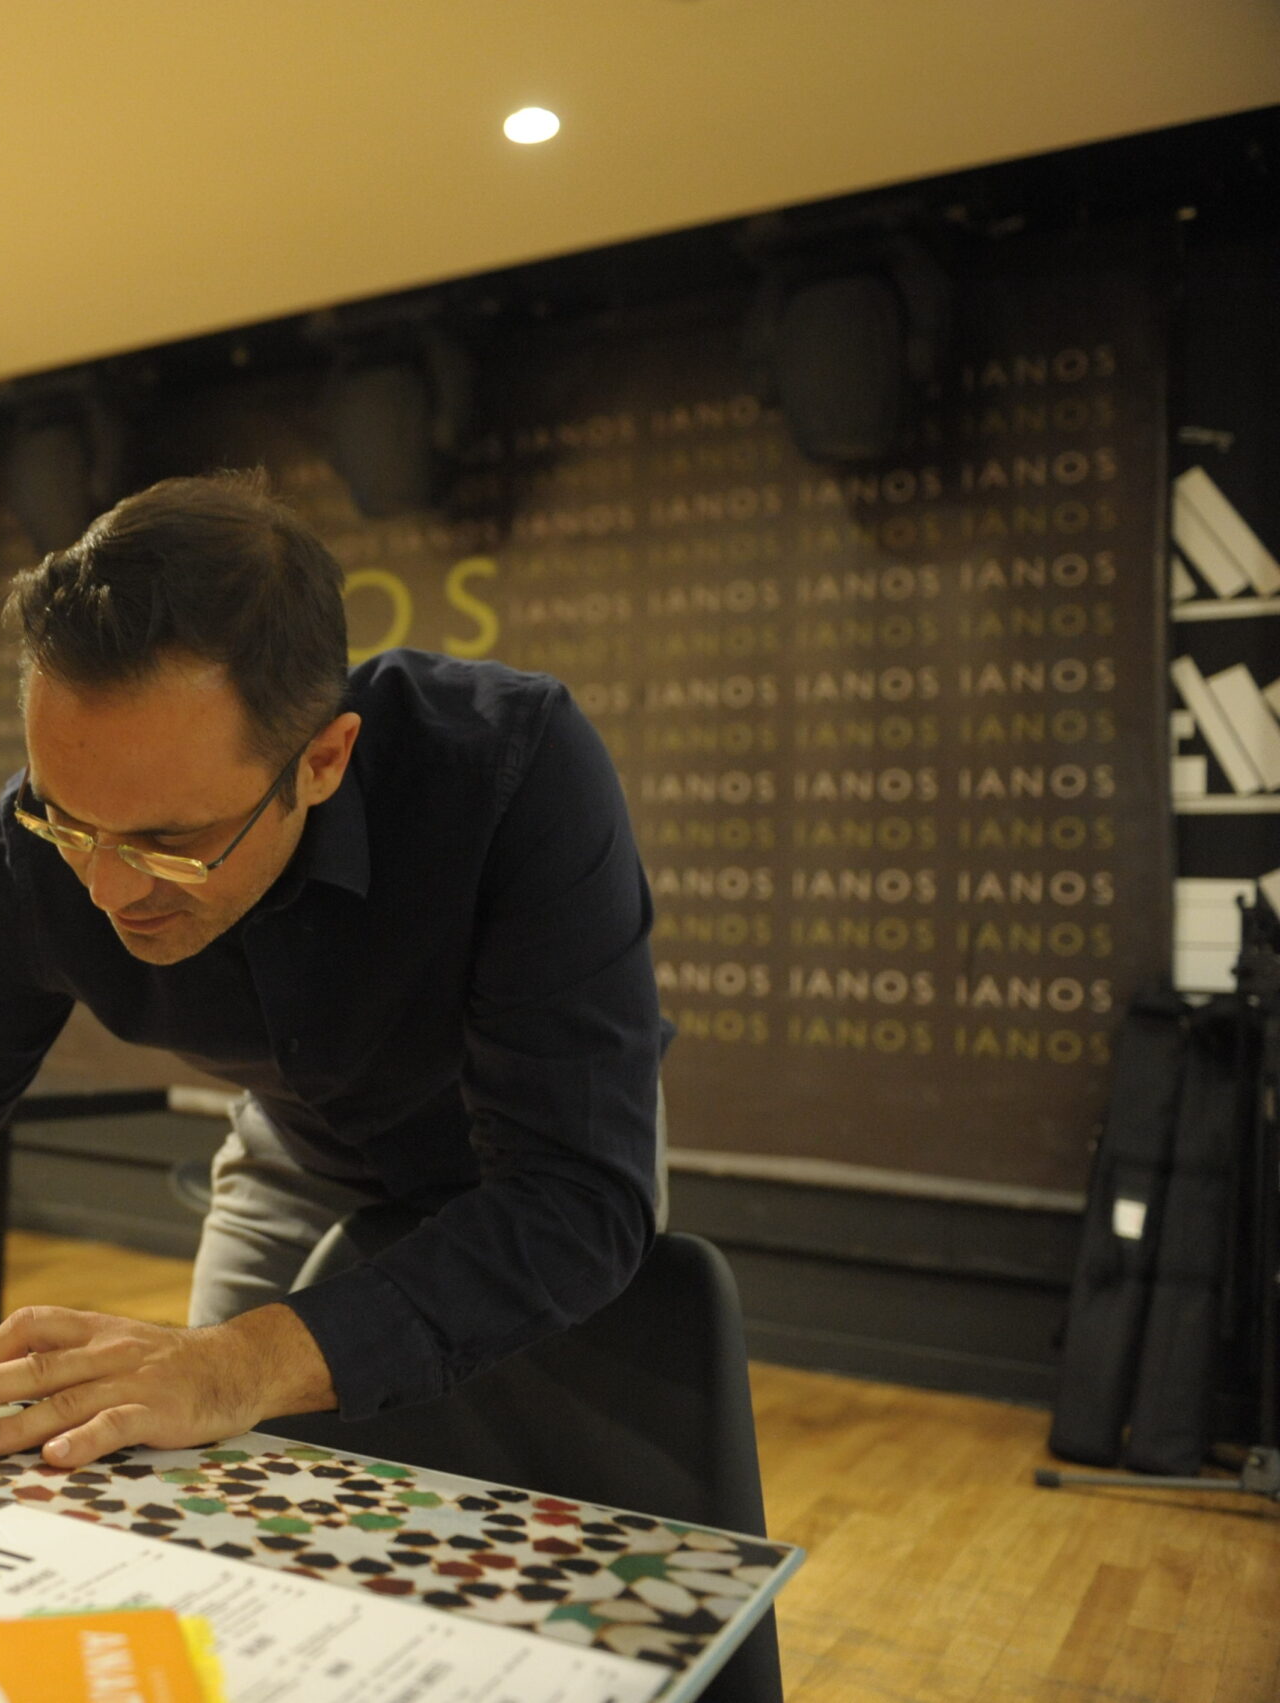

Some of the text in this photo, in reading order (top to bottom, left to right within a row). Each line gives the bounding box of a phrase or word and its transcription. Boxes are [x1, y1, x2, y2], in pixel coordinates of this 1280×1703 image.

[963, 345, 1117, 389] IANOS
[799, 468, 942, 508] IANOS
[961, 447, 1117, 492] IANOS
[961, 498, 1117, 537] IANOS
[796, 564, 941, 604] IANOS
[959, 551, 1117, 593] IANOS
[795, 612, 939, 650] IANOS
[960, 602, 1115, 638] IANOS
[795, 666, 940, 704] IANOS
[959, 657, 1116, 694] IANOS
[795, 715, 939, 749] IANOS
[959, 708, 1116, 744] IANOS
[793, 767, 938, 802] IANOS
[959, 763, 1116, 799] IANOS
[792, 816, 937, 850] IANOS
[958, 815, 1115, 851] IANOS
[791, 868, 936, 904] IANOS
[957, 870, 1114, 906] IANOS
[653, 913, 1113, 957] ANOS IANOS IANOS
[655, 961, 1113, 1014] ANOS IANOS IANOS
[788, 1015, 933, 1055] IANOS
[954, 1026, 1111, 1065] IANOS
